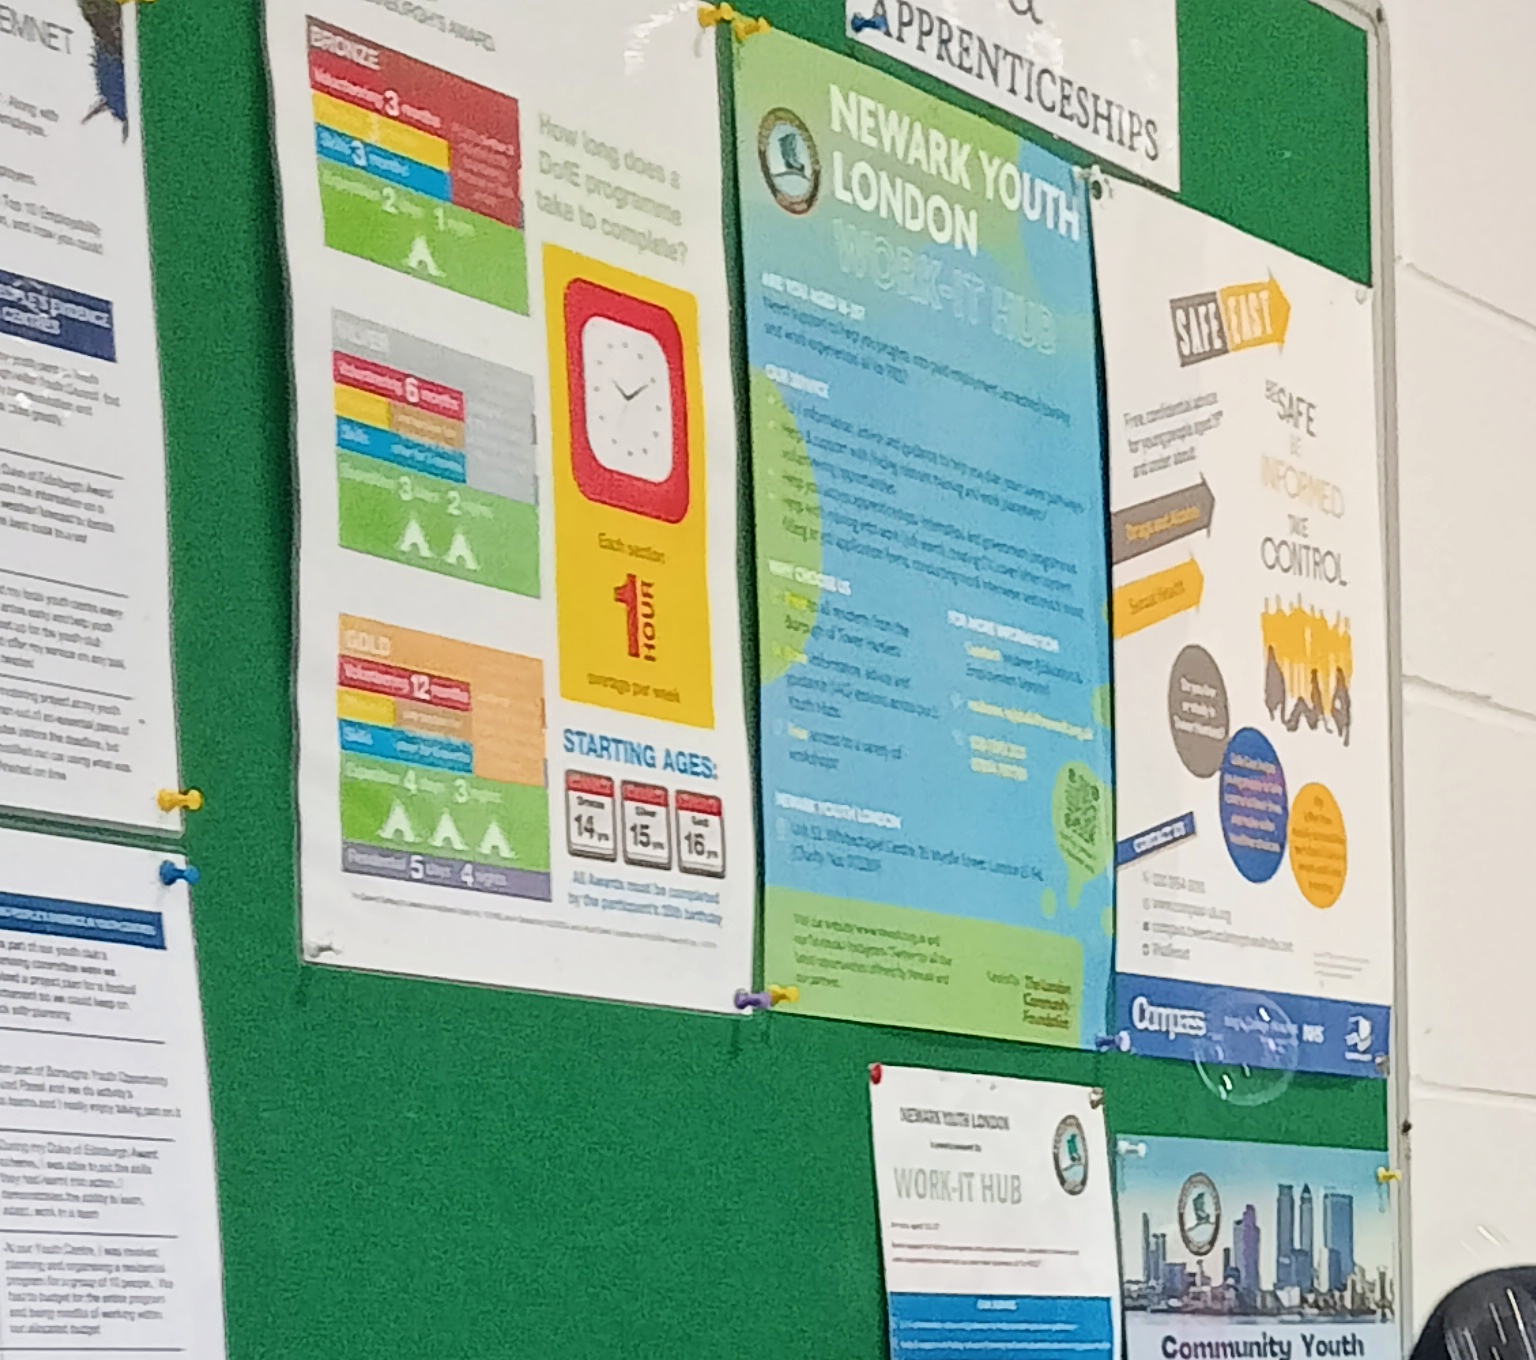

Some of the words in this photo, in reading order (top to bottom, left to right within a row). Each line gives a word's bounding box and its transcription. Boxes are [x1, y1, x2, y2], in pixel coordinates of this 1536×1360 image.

[309, 25, 382, 71] BRONZE
[868, 0, 1161, 162] APPRENTICESHIPS
[383, 90, 401, 117] 3
[350, 140, 368, 166] 3
[538, 112, 580, 148] How
[583, 131, 621, 172] long
[829, 83, 972, 191] NEWARK
[979, 149, 1081, 242] YOUTH
[381, 188, 398, 215] 2
[831, 151, 979, 257] LONDON
[1175, 301, 1223, 357] SAFE
[1226, 289, 1274, 346] EAST
[403, 377, 420, 405] 6
[1277, 386, 1317, 438] SAFE
[399, 476, 414, 501] 3
[447, 490, 462, 517] 2
[1260, 536, 1350, 587] CONTROL
[613, 572, 640, 660] 1
[640, 579, 658, 663] HOUR
[409, 673, 431, 701] 12
[563, 727, 657, 770] STARTING
[662, 747, 719, 781] AGES:
[403, 769, 418, 796] 4
[453, 778, 469, 804] 3
[573, 812, 596, 840] 14
[629, 821, 652, 848] 15
[684, 829, 706, 857] 16
[408, 853, 425, 881] 5
[459, 861, 476, 888] 4
[893, 1167, 975, 1203] WORK-IT
[980, 1174, 1023, 1206] HUB
[1301, 1332, 1366, 1359] Youth
